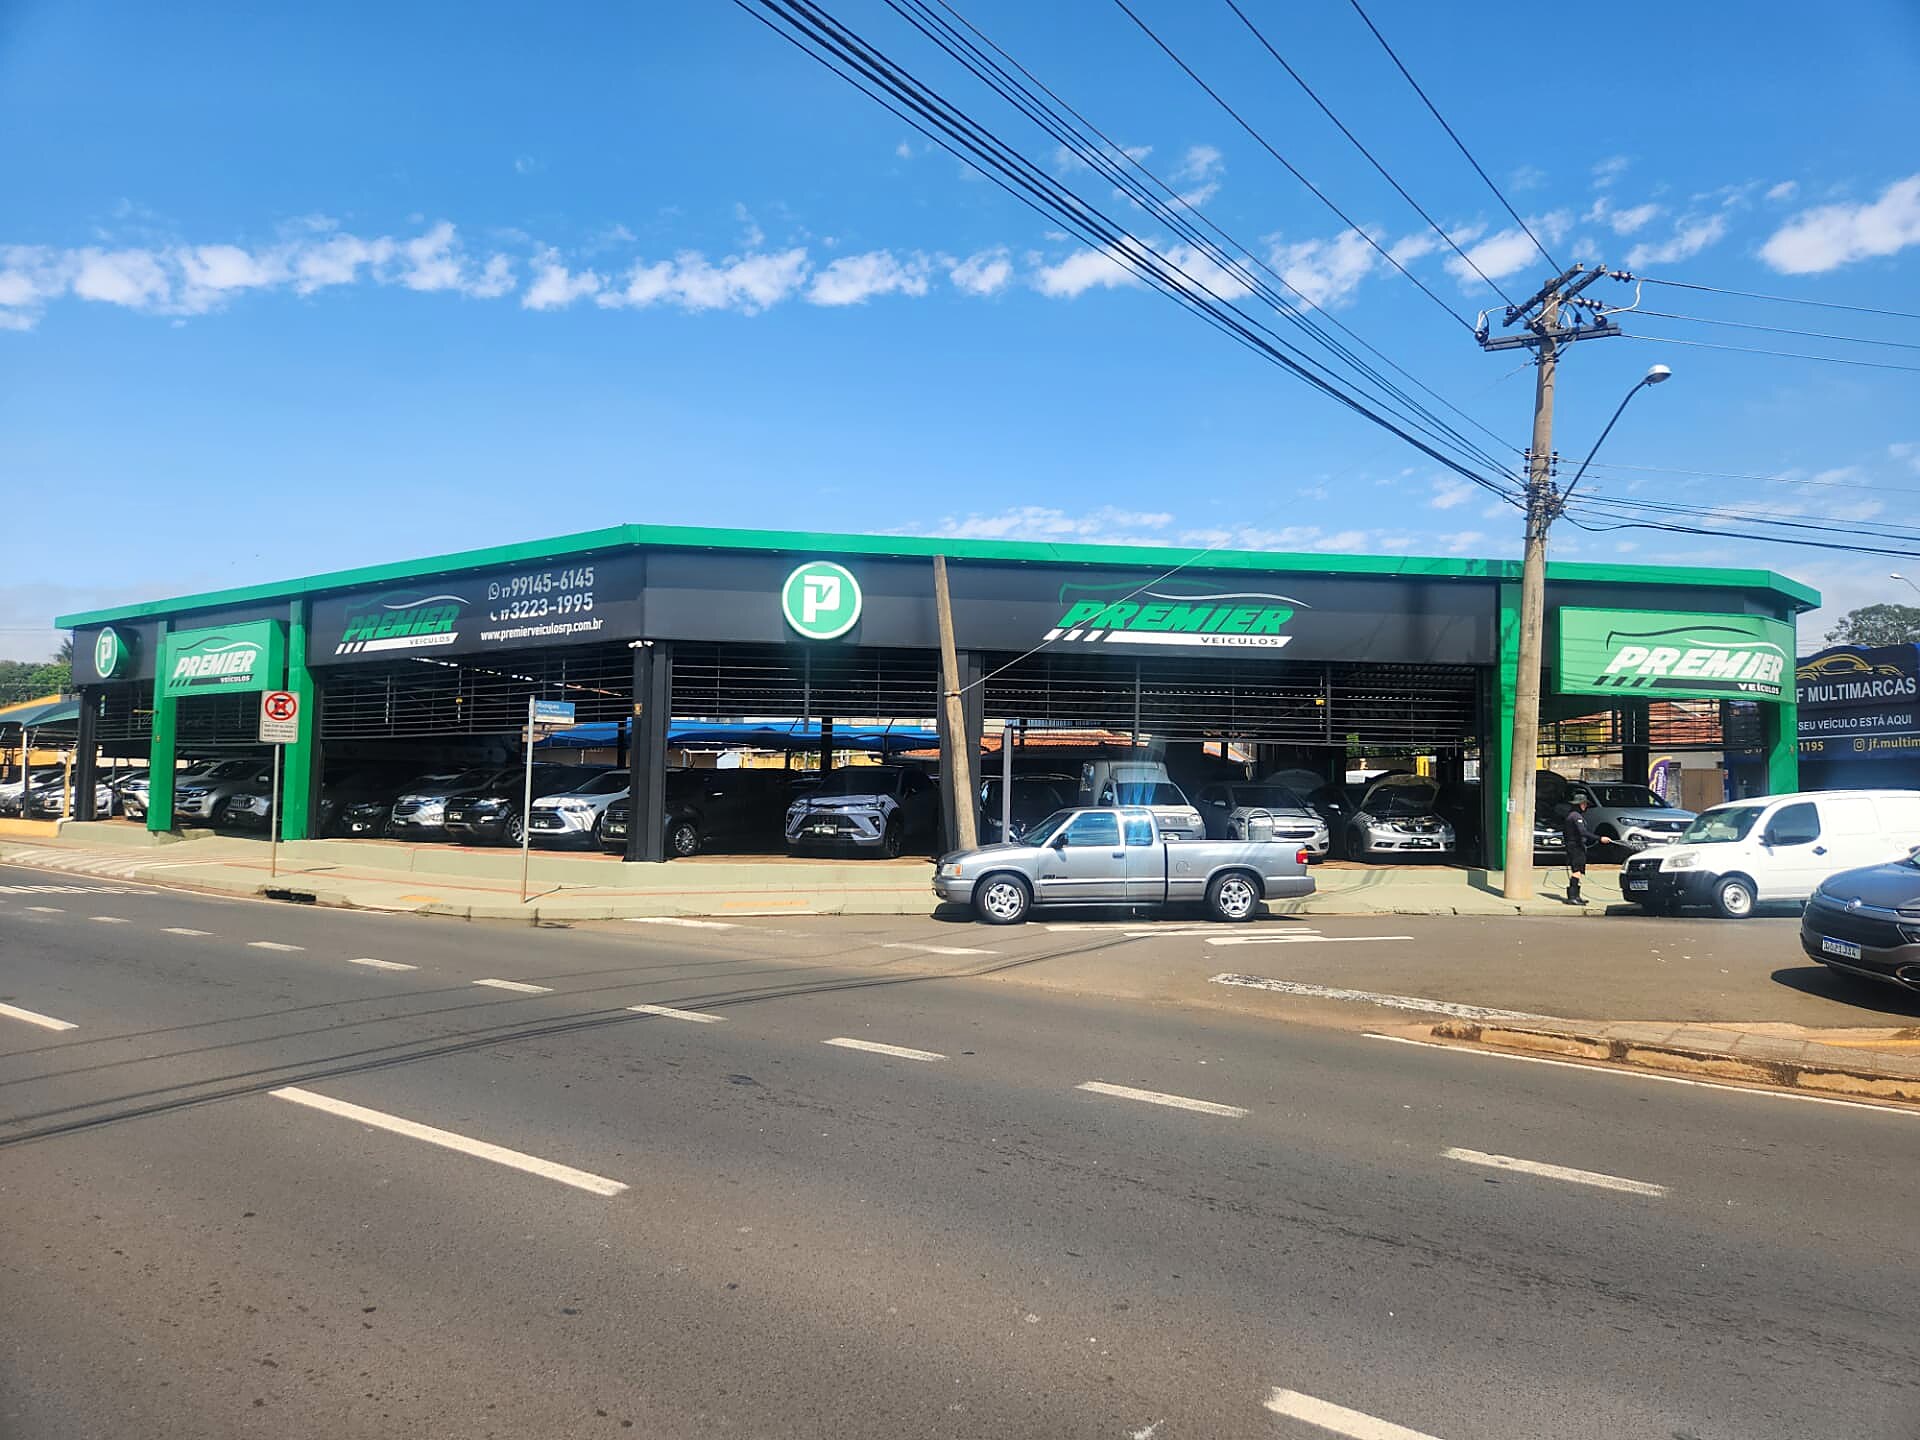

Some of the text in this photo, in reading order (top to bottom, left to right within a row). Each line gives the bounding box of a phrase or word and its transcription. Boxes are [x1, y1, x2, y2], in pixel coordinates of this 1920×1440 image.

[502, 567, 594, 598] 17 99145-6145
[510, 592, 593, 618] 3223-1995
[1056, 600, 1294, 634] PREMIER
[342, 604, 460, 642] PREMIER
[480, 618, 603, 642] www.premierveiculosrp.com.br
[172, 650, 258, 678] PREMIER
[1604, 646, 1784, 683] PREMIER
[1808, 677, 1917, 702] MULTIMARCAS
[1798, 721, 1815, 731] SEU
[1886, 714, 1912, 726] AQUI
